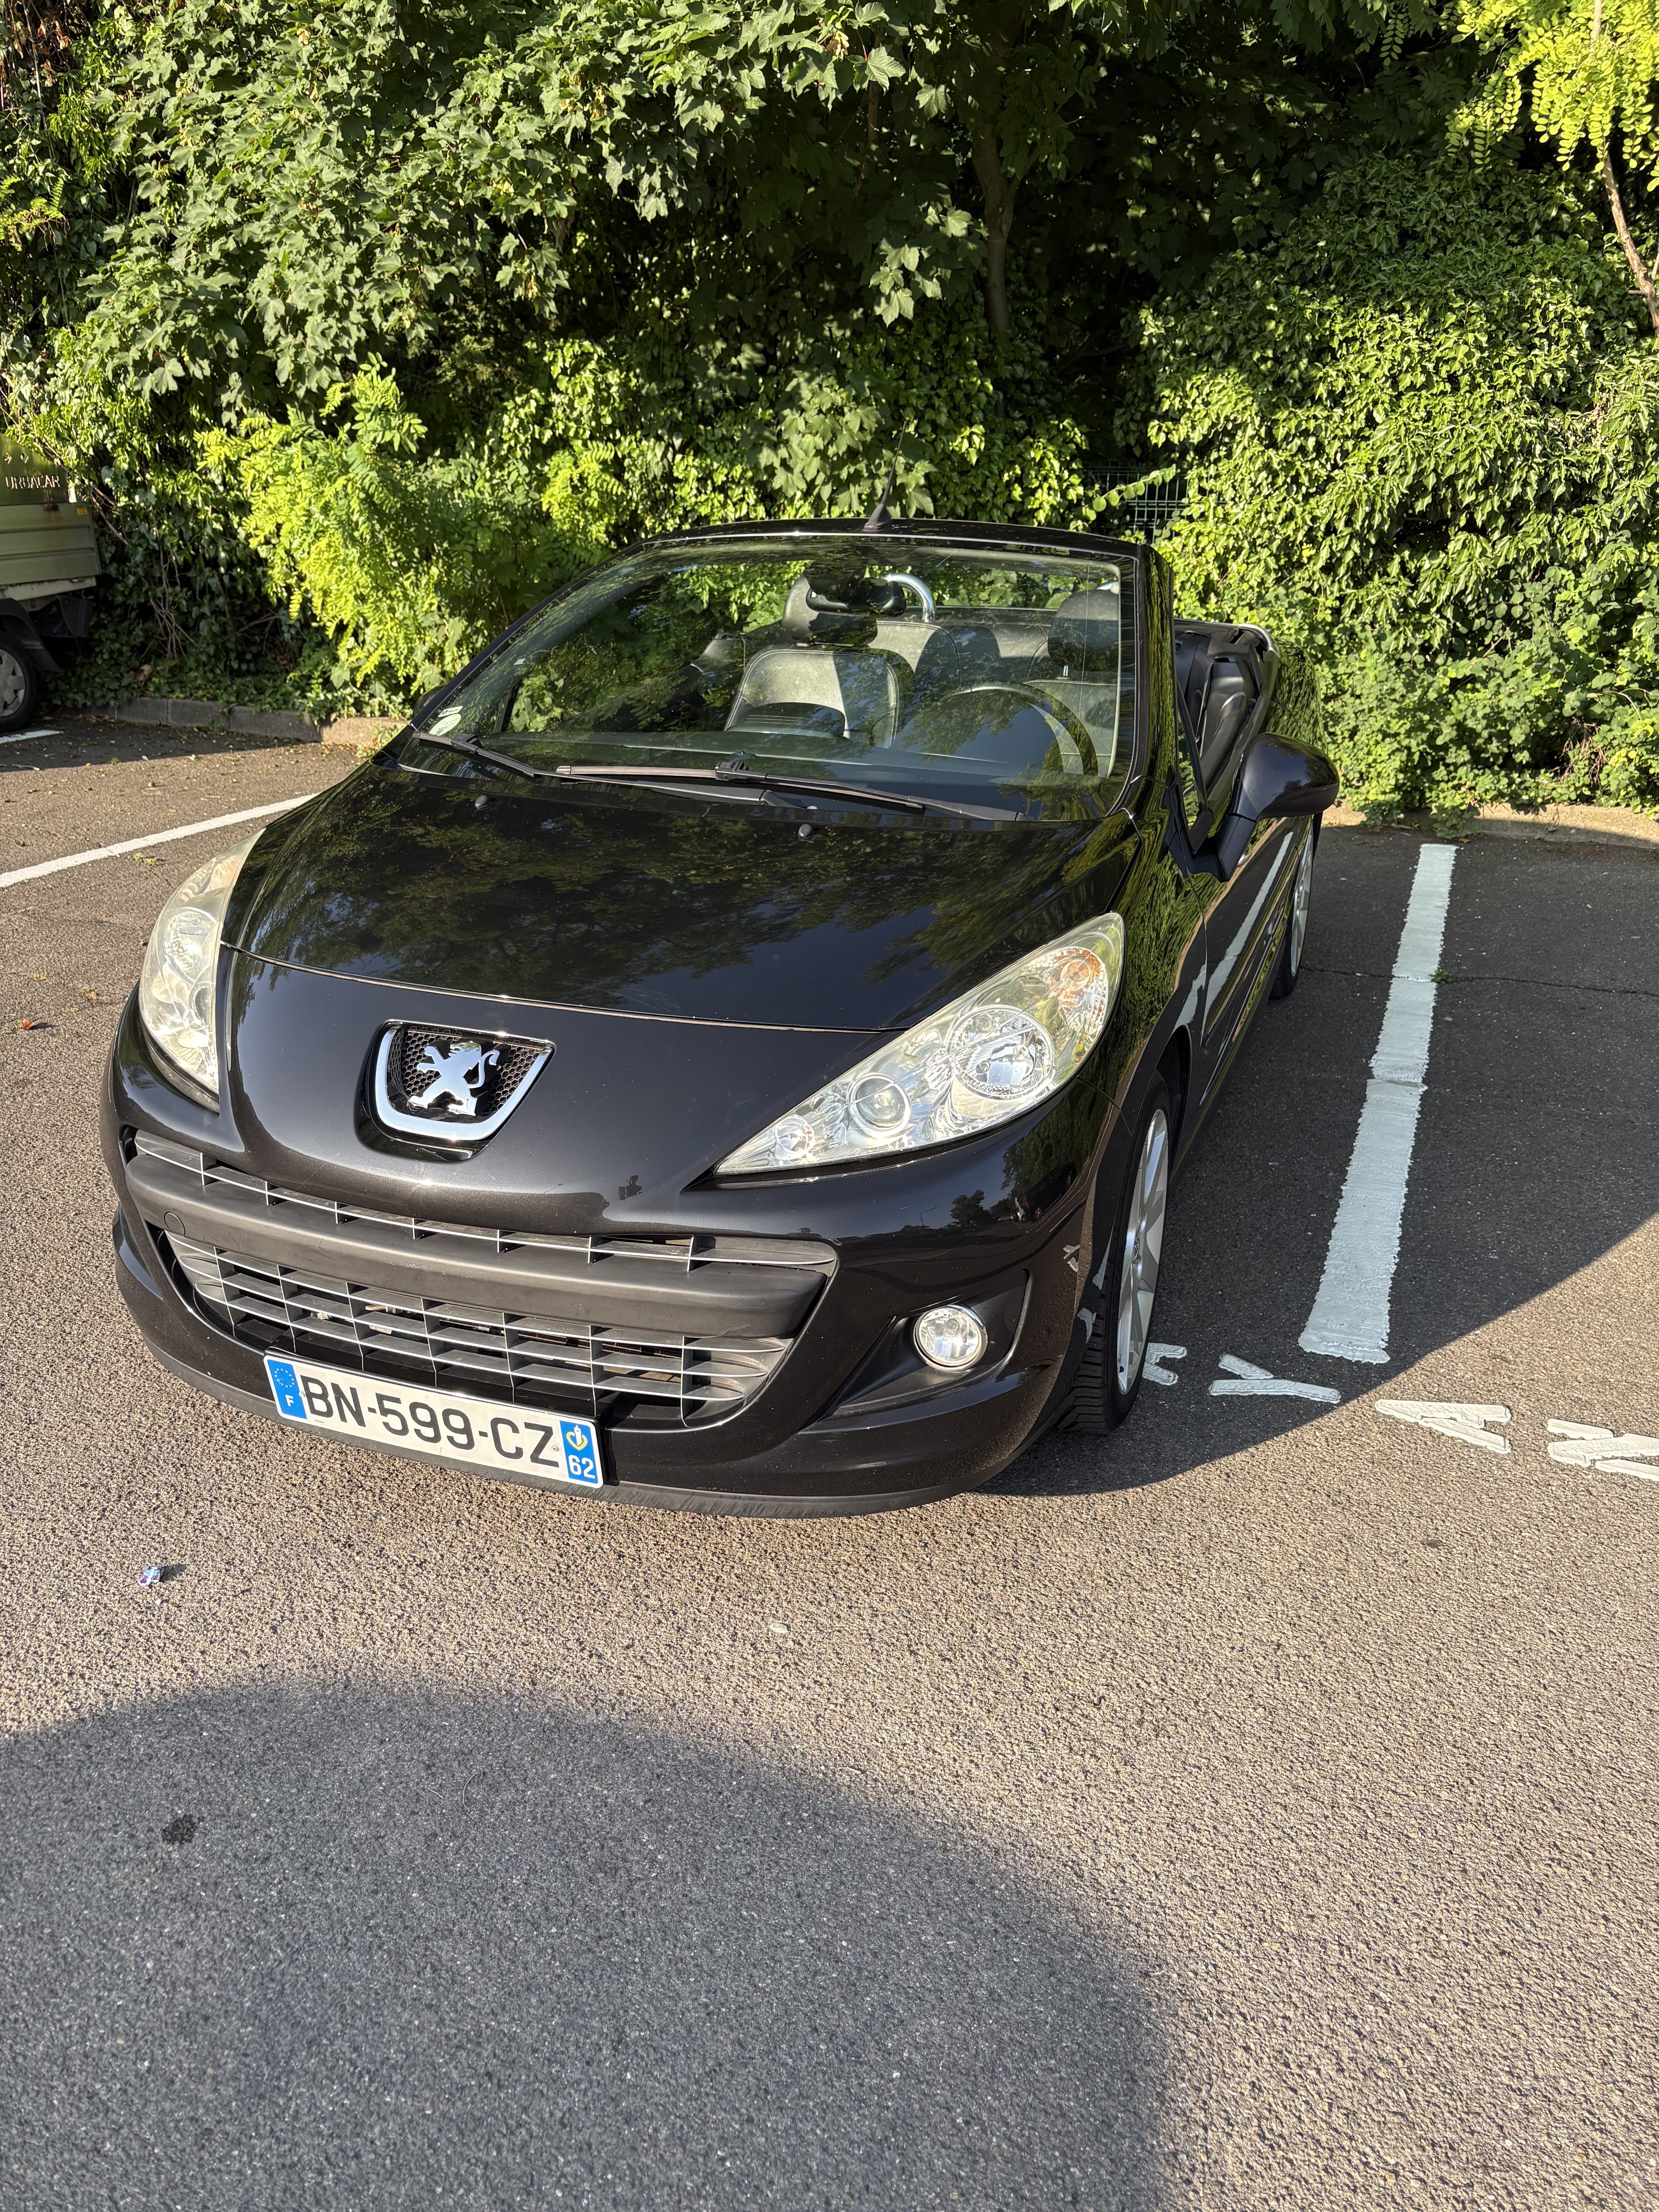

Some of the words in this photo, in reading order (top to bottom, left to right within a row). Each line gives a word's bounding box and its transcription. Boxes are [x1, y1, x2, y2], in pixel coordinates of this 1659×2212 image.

[5, 475, 60, 489] URBACAR
[285, 1395, 294, 1407] F
[300, 1375, 559, 1468] BN-599-CZ
[568, 1455, 595, 1479] 62
